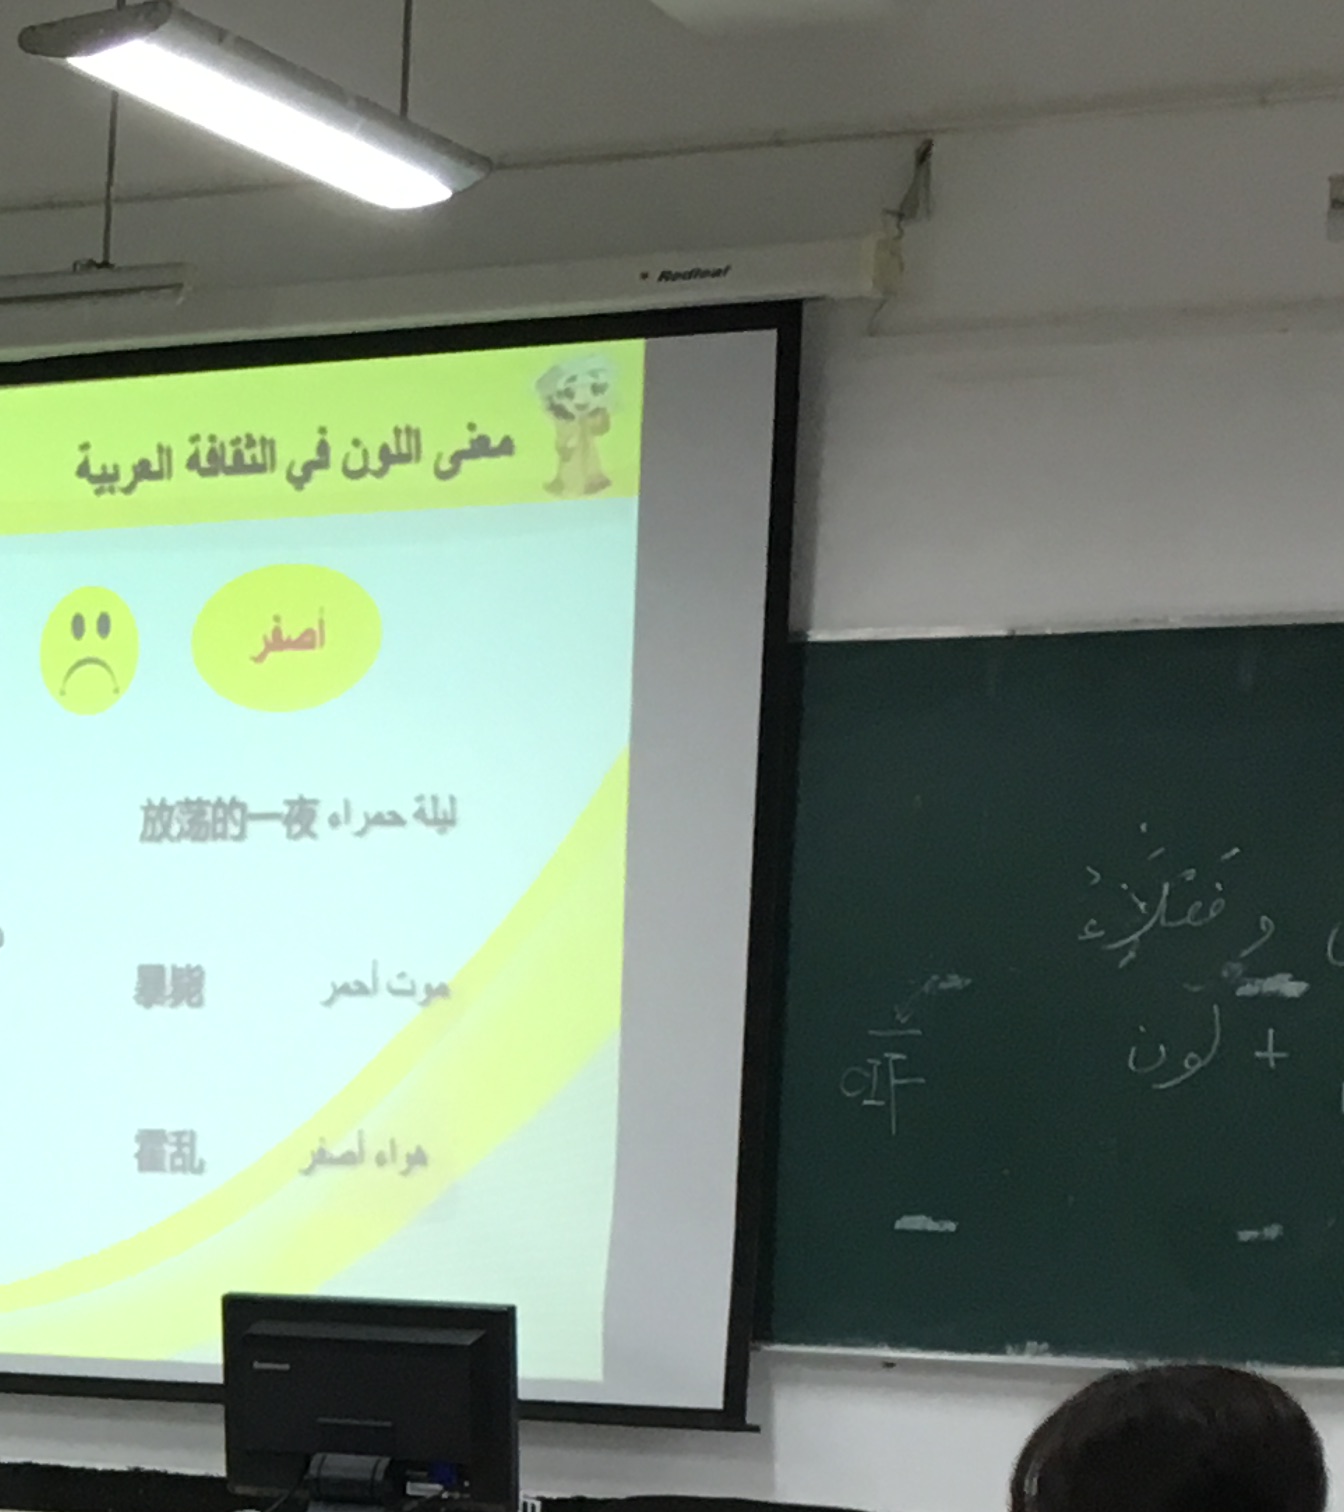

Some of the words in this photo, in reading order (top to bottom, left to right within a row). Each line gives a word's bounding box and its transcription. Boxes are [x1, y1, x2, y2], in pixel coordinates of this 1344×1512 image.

[75, 442, 173, 497] العربية
[184, 432, 276, 479] الثقافة
[285, 425, 332, 491] في
[340, 424, 422, 480] اللون
[433, 421, 515, 481] معنى
[249, 606, 326, 663] أصفر
[326, 797, 408, 838] حمراء
[412, 793, 458, 836] ليلة
[385, 970, 452, 1009] موت
[133, 1128, 206, 1176] 霍乱
[374, 1136, 429, 1178] هواء
